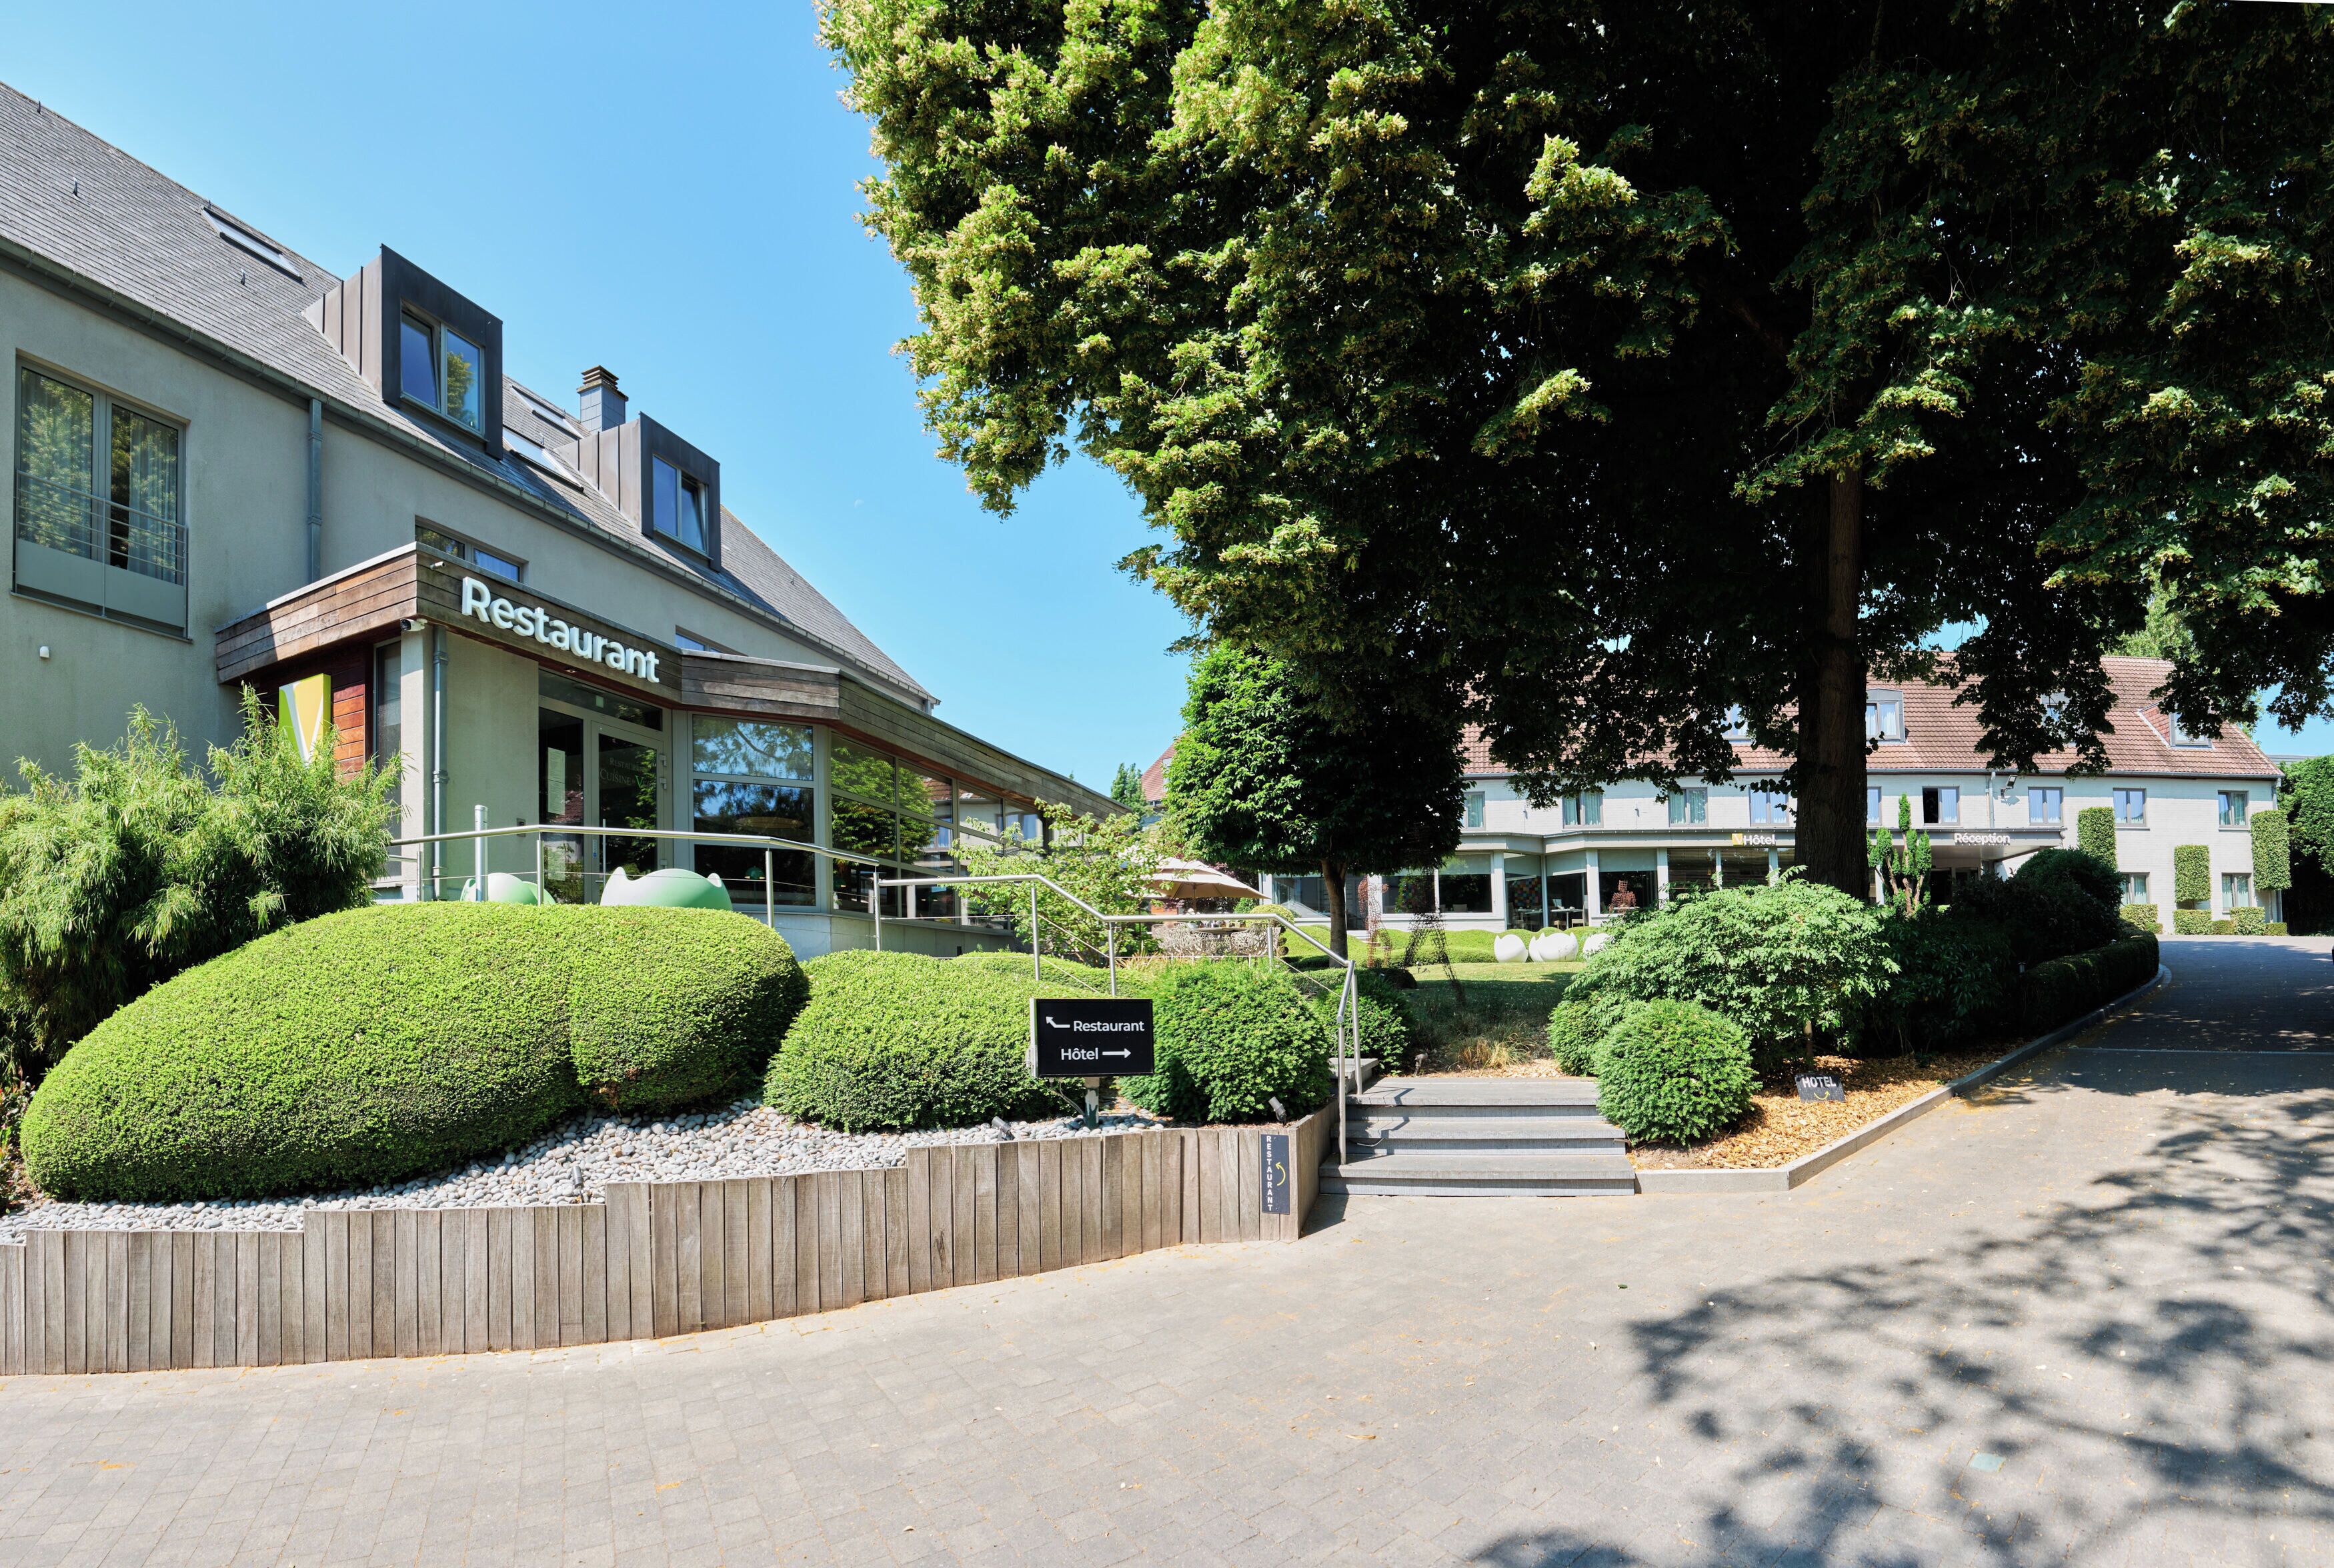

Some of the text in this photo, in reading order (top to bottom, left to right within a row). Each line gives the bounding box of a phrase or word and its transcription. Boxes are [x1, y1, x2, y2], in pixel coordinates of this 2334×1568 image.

[461, 576, 660, 683] Restaurant
[1743, 834, 1775, 845] Hôtel
[1954, 832, 2011, 845] Réception
[1073, 1020, 1145, 1032] Restaurant
[1060, 1047, 1099, 1061] Hôtel
[1801, 1076, 1837, 1088] HOTEL
